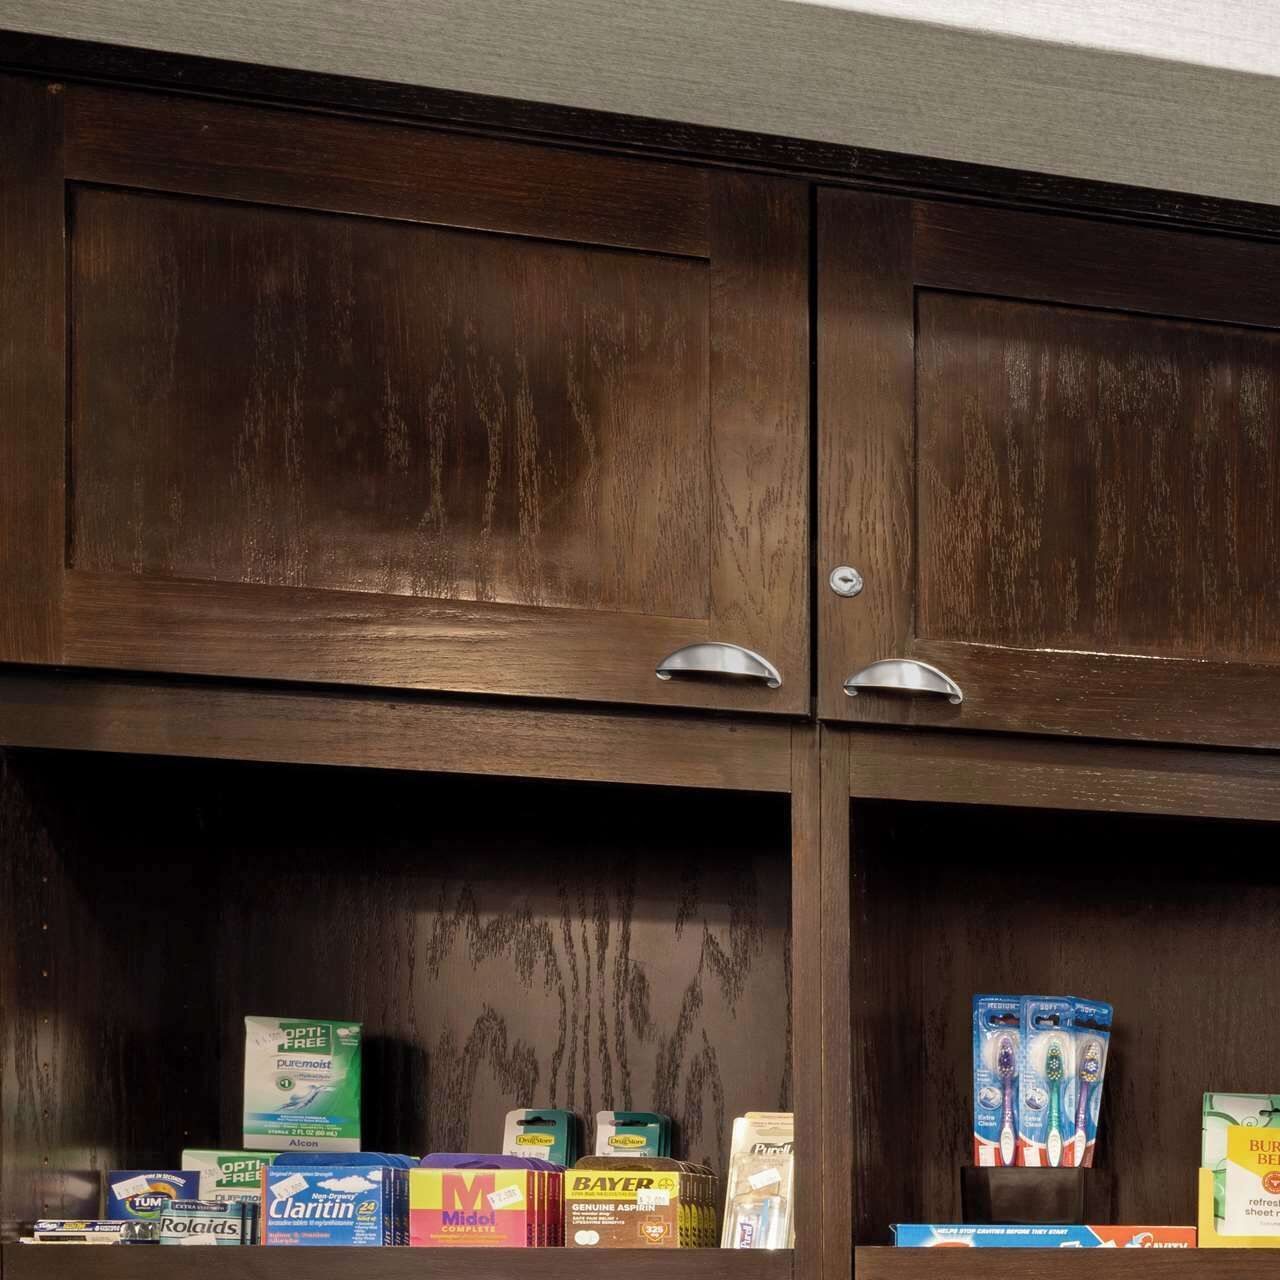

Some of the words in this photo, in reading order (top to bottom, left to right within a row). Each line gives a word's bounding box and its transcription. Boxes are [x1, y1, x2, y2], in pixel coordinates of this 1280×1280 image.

[284, 1037, 327, 1049] FREE
[572, 1176, 655, 1191] BAYER
[269, 1197, 354, 1219] Claritin
[359, 1202, 377, 1213] 24
[571, 1203, 615, 1212] GENUINE
[617, 1204, 656, 1212] ASPIRIN
[441, 1210, 496, 1226] Midol
[159, 1217, 238, 1236] Rolaids
